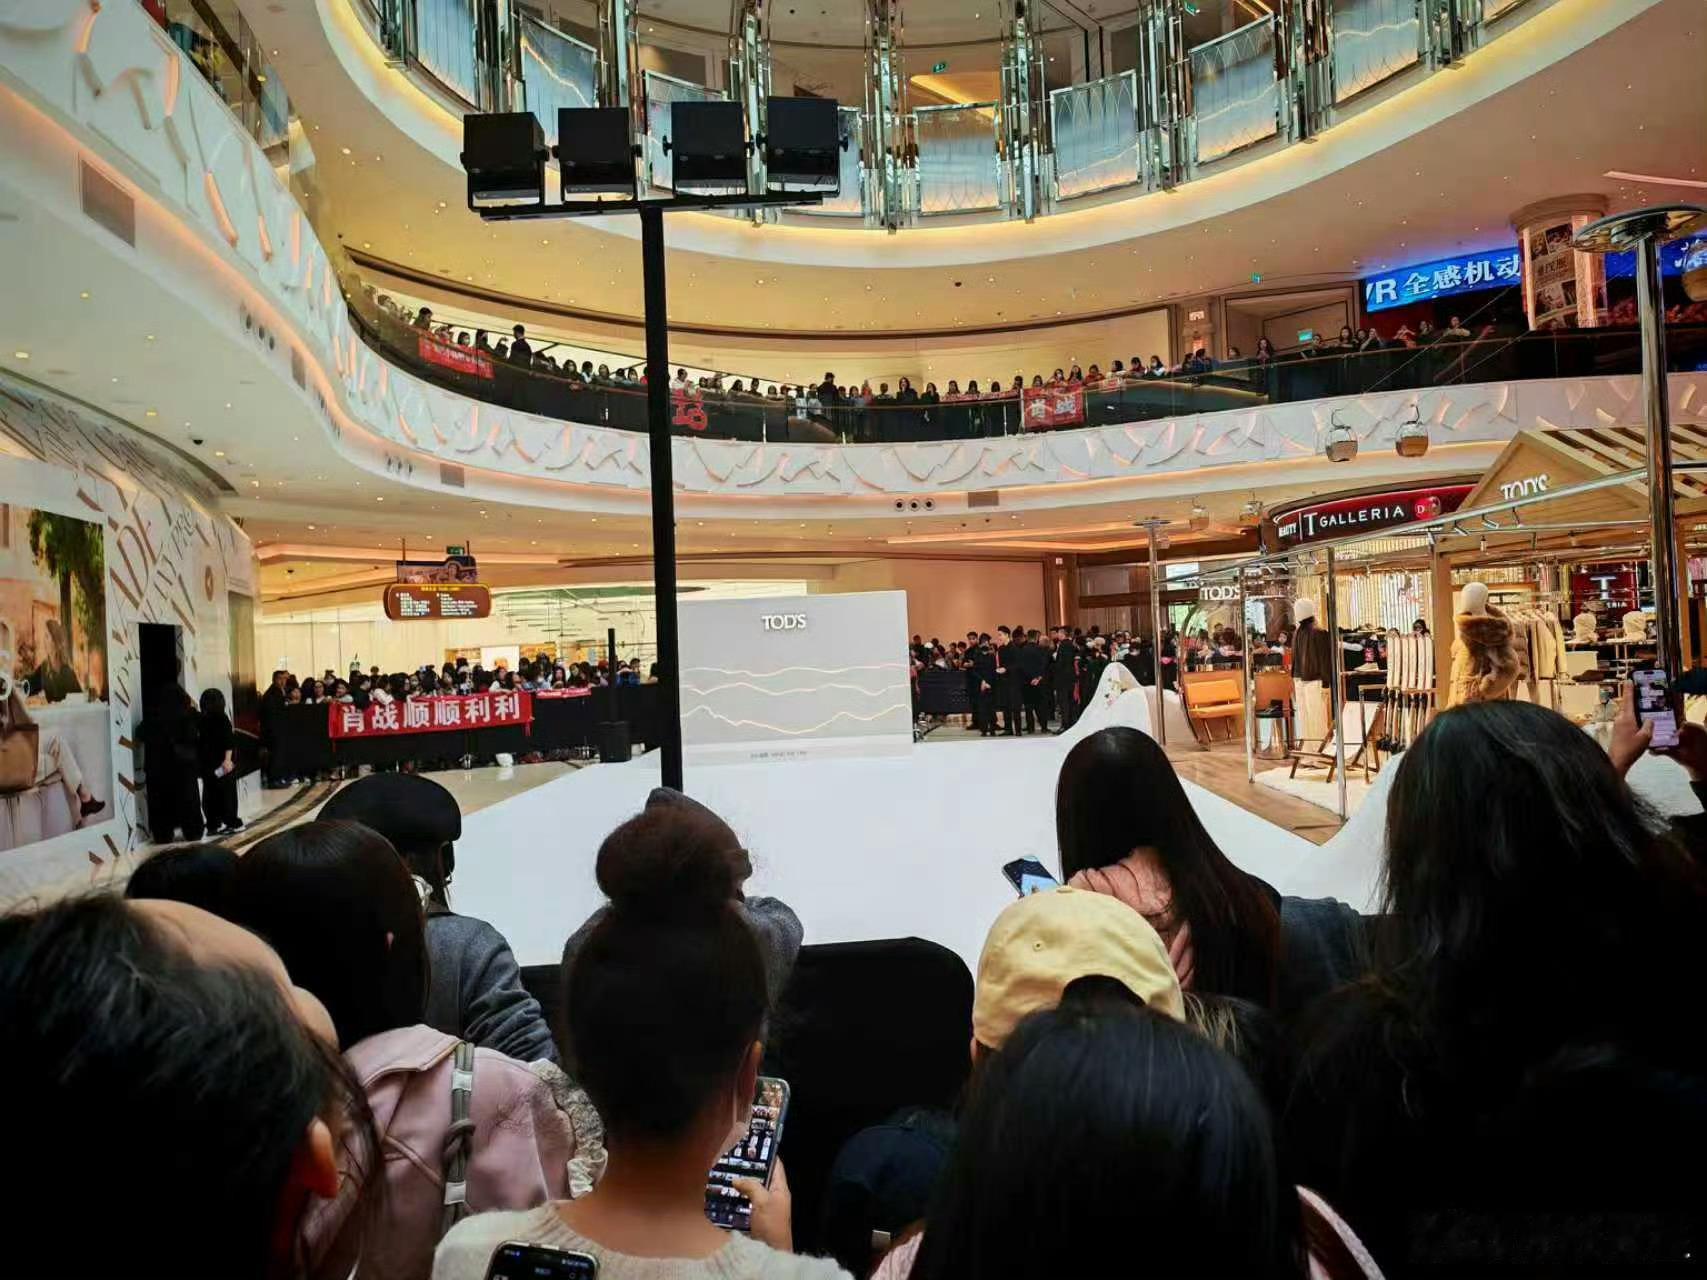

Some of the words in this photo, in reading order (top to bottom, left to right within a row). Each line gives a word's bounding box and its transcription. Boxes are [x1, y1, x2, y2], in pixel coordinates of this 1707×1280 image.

[1319, 505, 1405, 528] GALLERIA
[761, 613, 807, 630] TOD'S
[342, 693, 520, 733] 肖战顺顺利利
